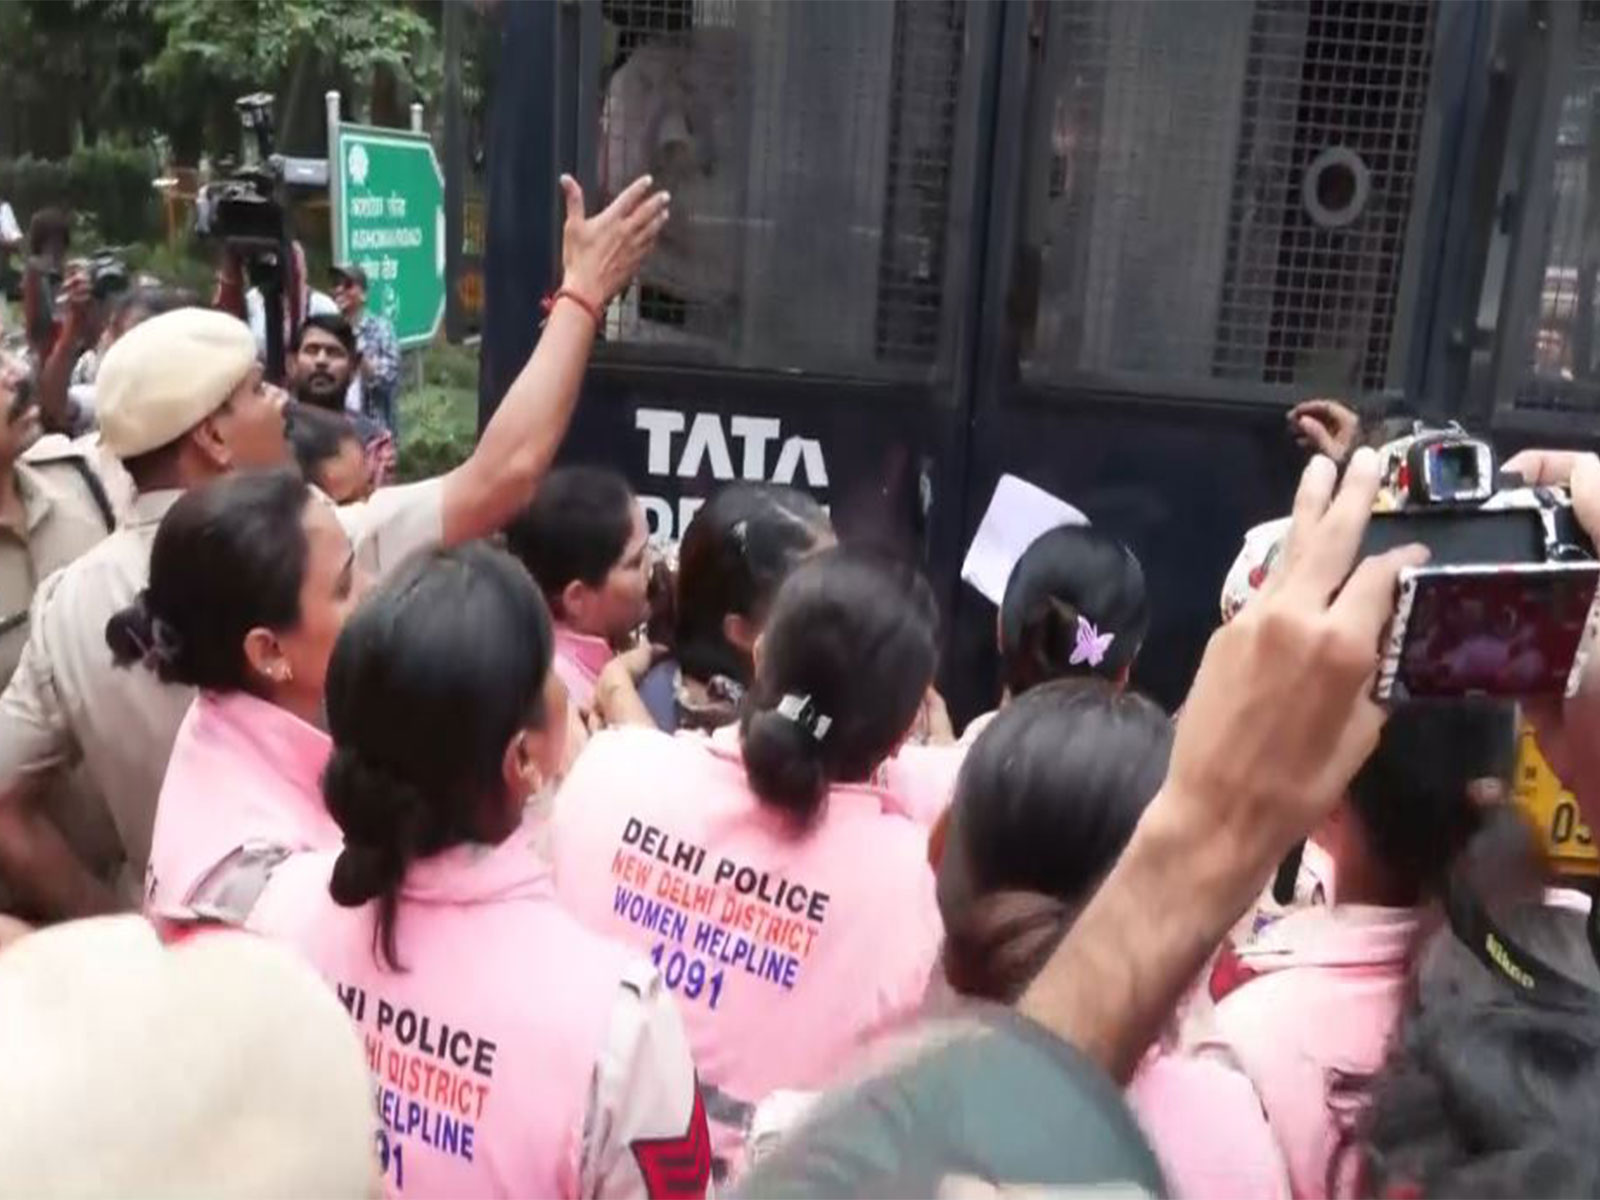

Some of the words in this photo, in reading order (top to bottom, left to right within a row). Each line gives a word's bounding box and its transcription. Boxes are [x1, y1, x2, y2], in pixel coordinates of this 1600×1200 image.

[635, 408, 829, 487] TATA
[611, 848, 653, 889] NEW
[657, 871, 718, 915] DELHI
[720, 892, 819, 958] DISTRICT
[622, 817, 707, 875] DELHI
[714, 859, 830, 923] POLICE
[613, 885, 688, 943] WOMEN
[694, 921, 799, 990] HELPLINE
[651, 942, 724, 1009] 1091
[377, 999, 497, 1076] POLICE
[388, 1050, 490, 1121] DISTRICT
